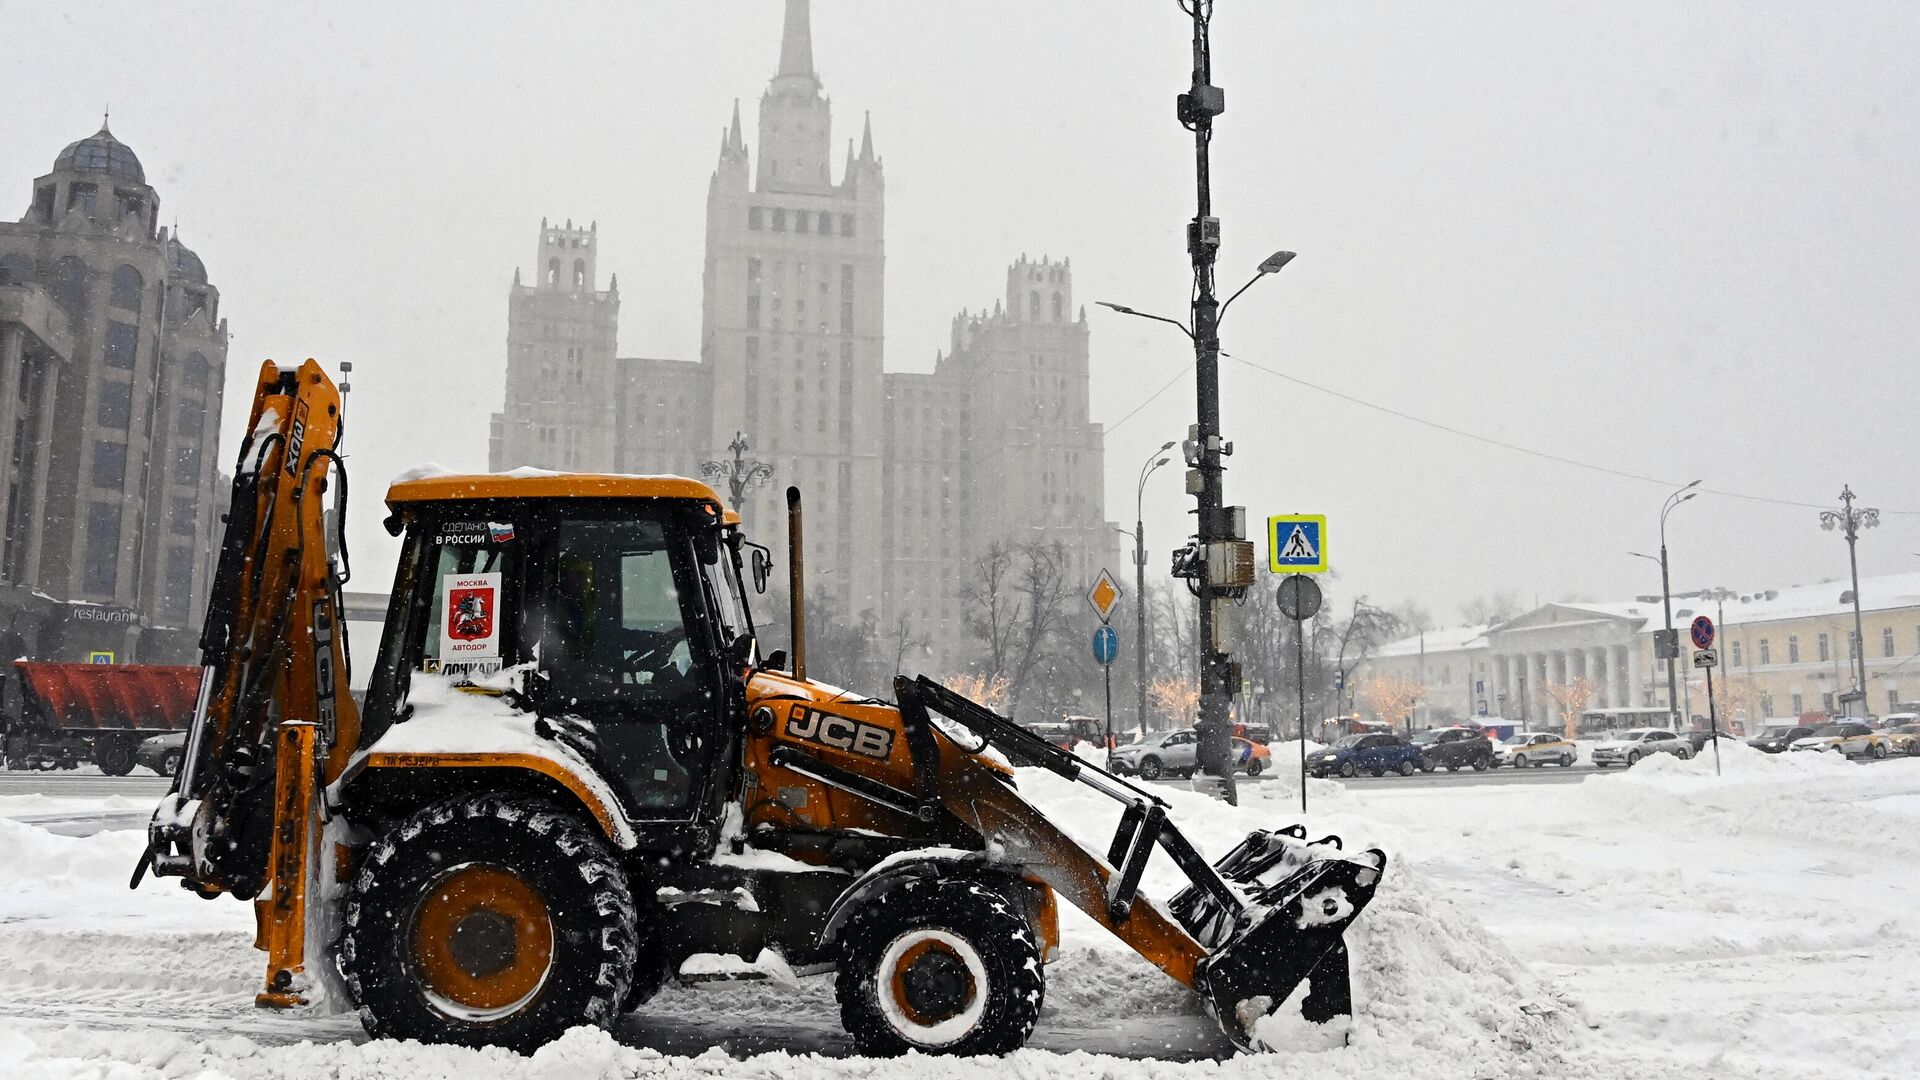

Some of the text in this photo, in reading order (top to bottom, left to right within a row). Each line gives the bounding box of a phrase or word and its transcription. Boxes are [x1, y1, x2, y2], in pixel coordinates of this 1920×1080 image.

[442, 522, 487, 532] СДЕЛАНО
[435, 534, 485, 545] В РОССИИ
[73, 608, 135, 622] restaurant
[452, 643, 487, 651] АВТОДОР
[788, 706, 891, 758] JCB
